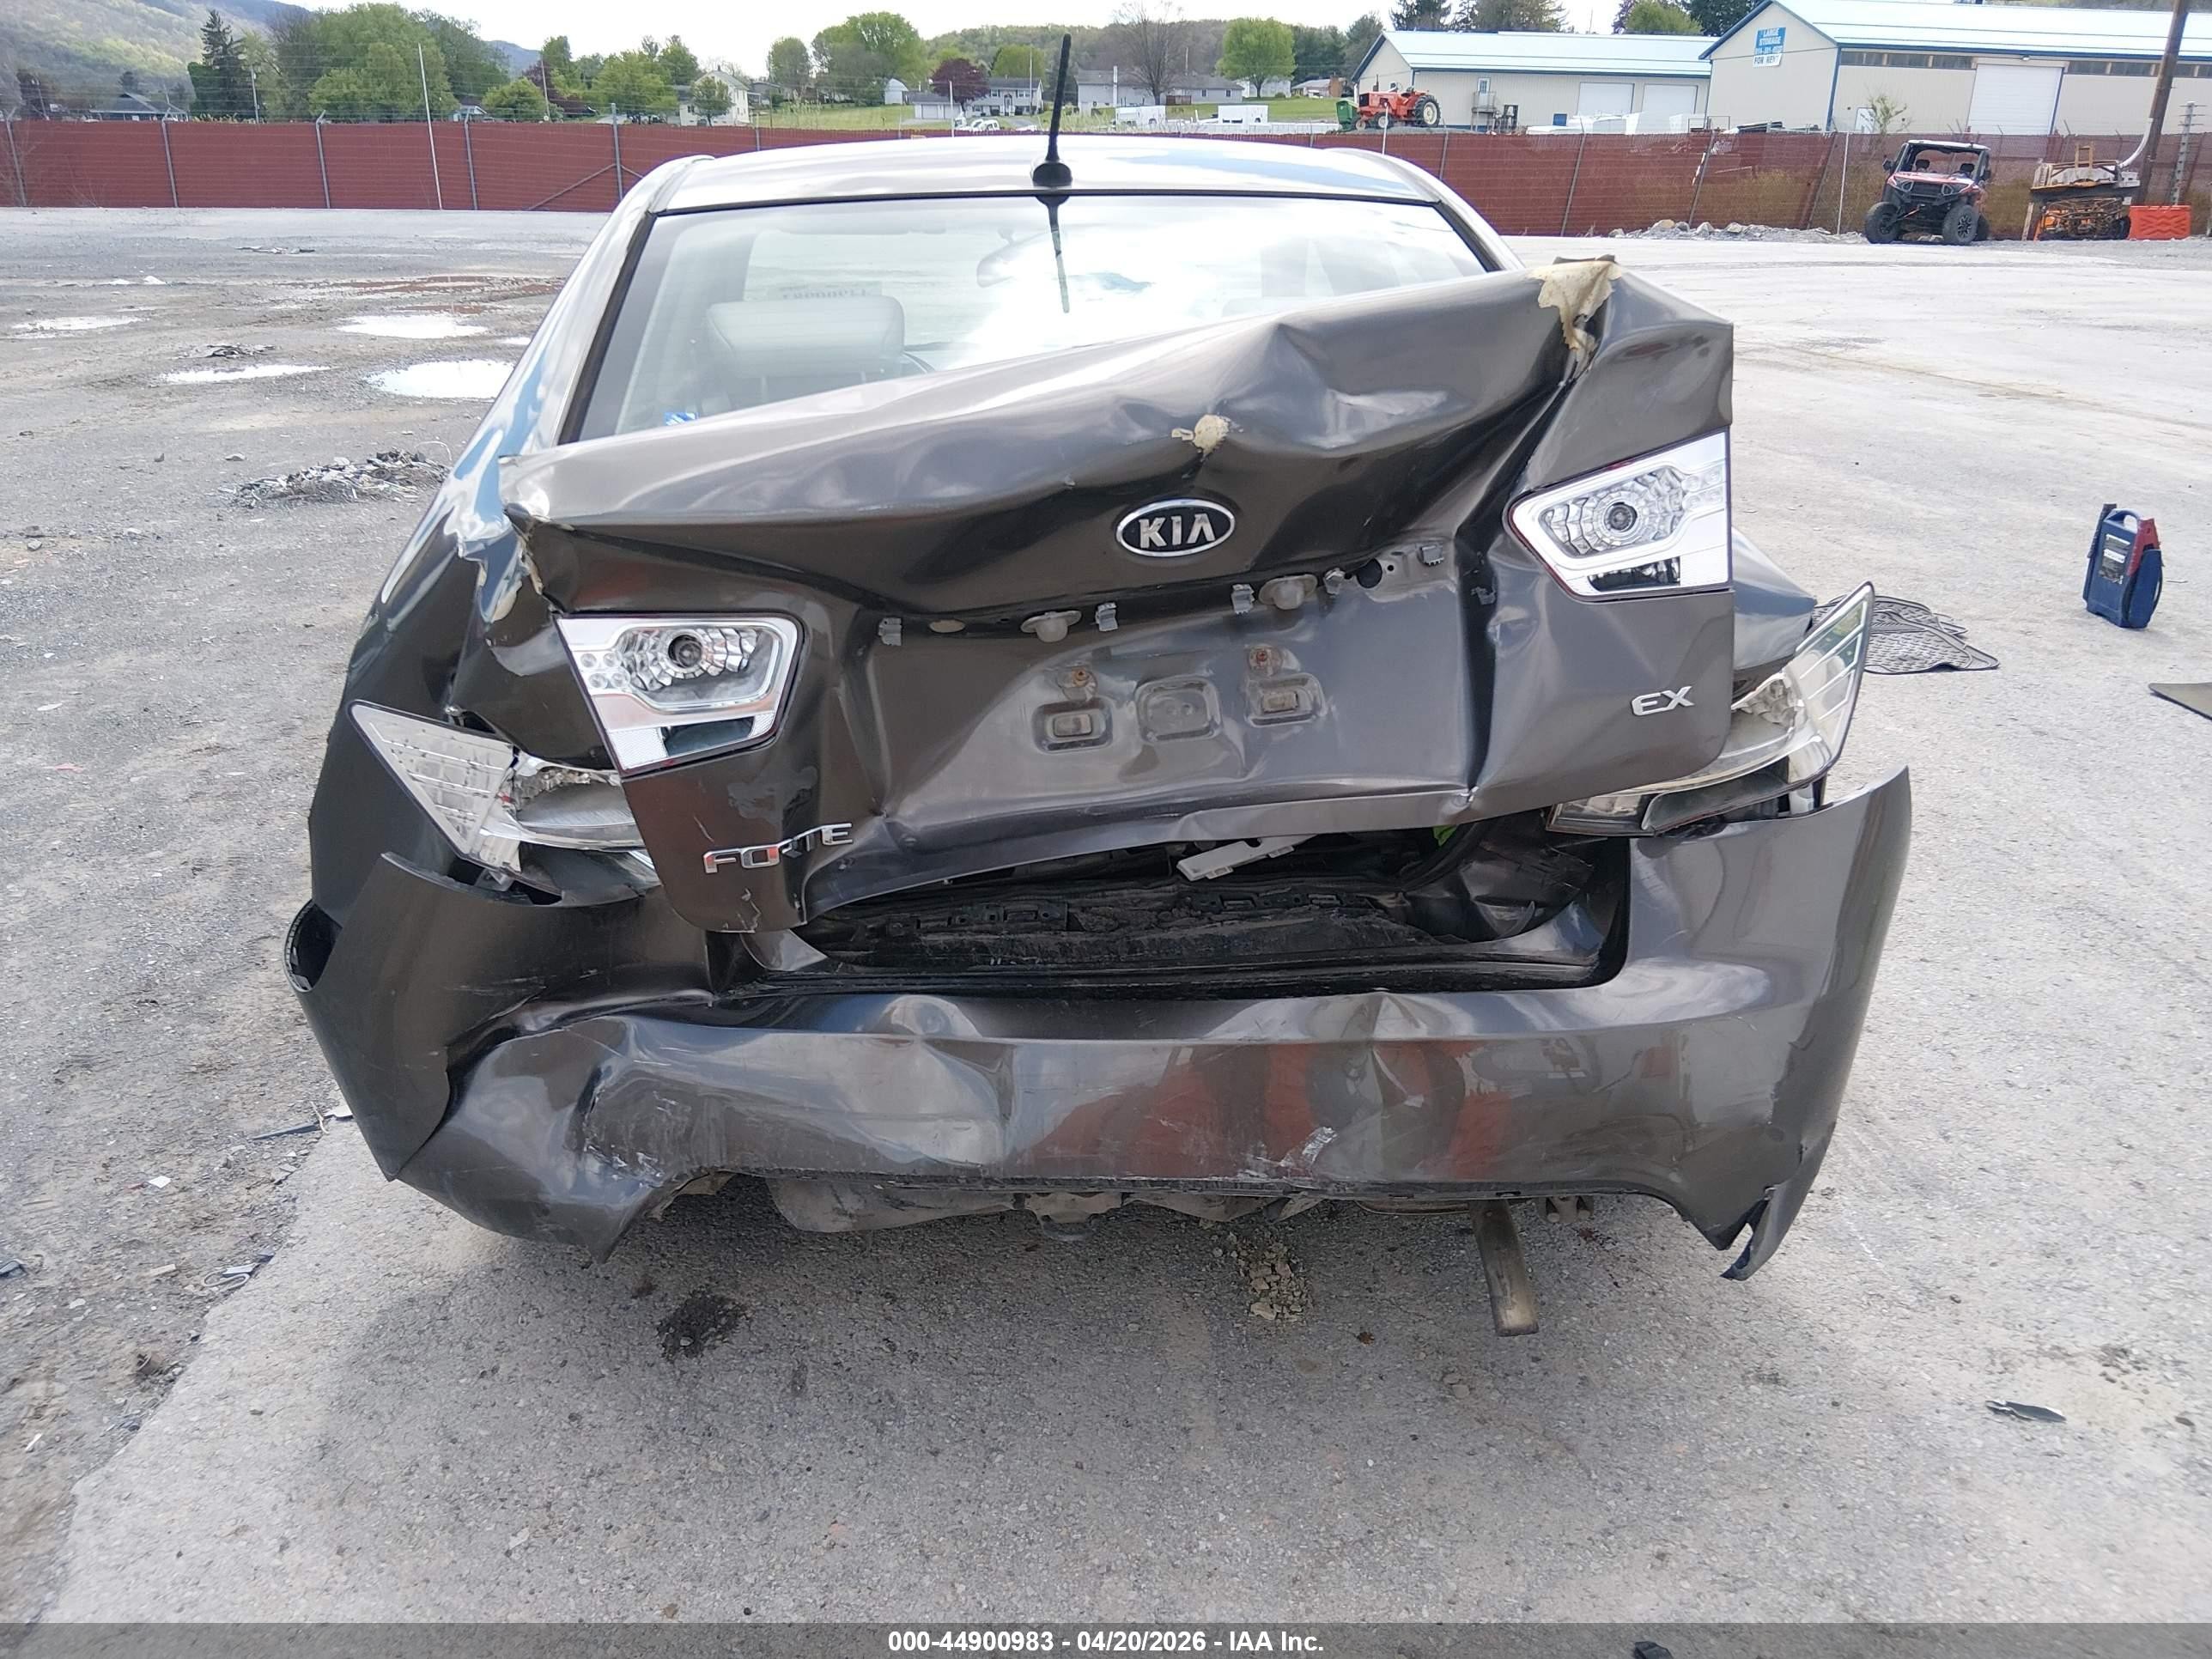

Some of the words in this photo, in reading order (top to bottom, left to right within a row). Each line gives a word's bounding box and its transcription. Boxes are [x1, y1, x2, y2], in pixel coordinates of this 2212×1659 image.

[1753, 56, 1765, 64] FOR
[1765, 54, 1780, 64] RENT
[1138, 513, 1216, 549] KIA
[1631, 684, 1695, 716] EX
[702, 822, 854, 874] FORTE
